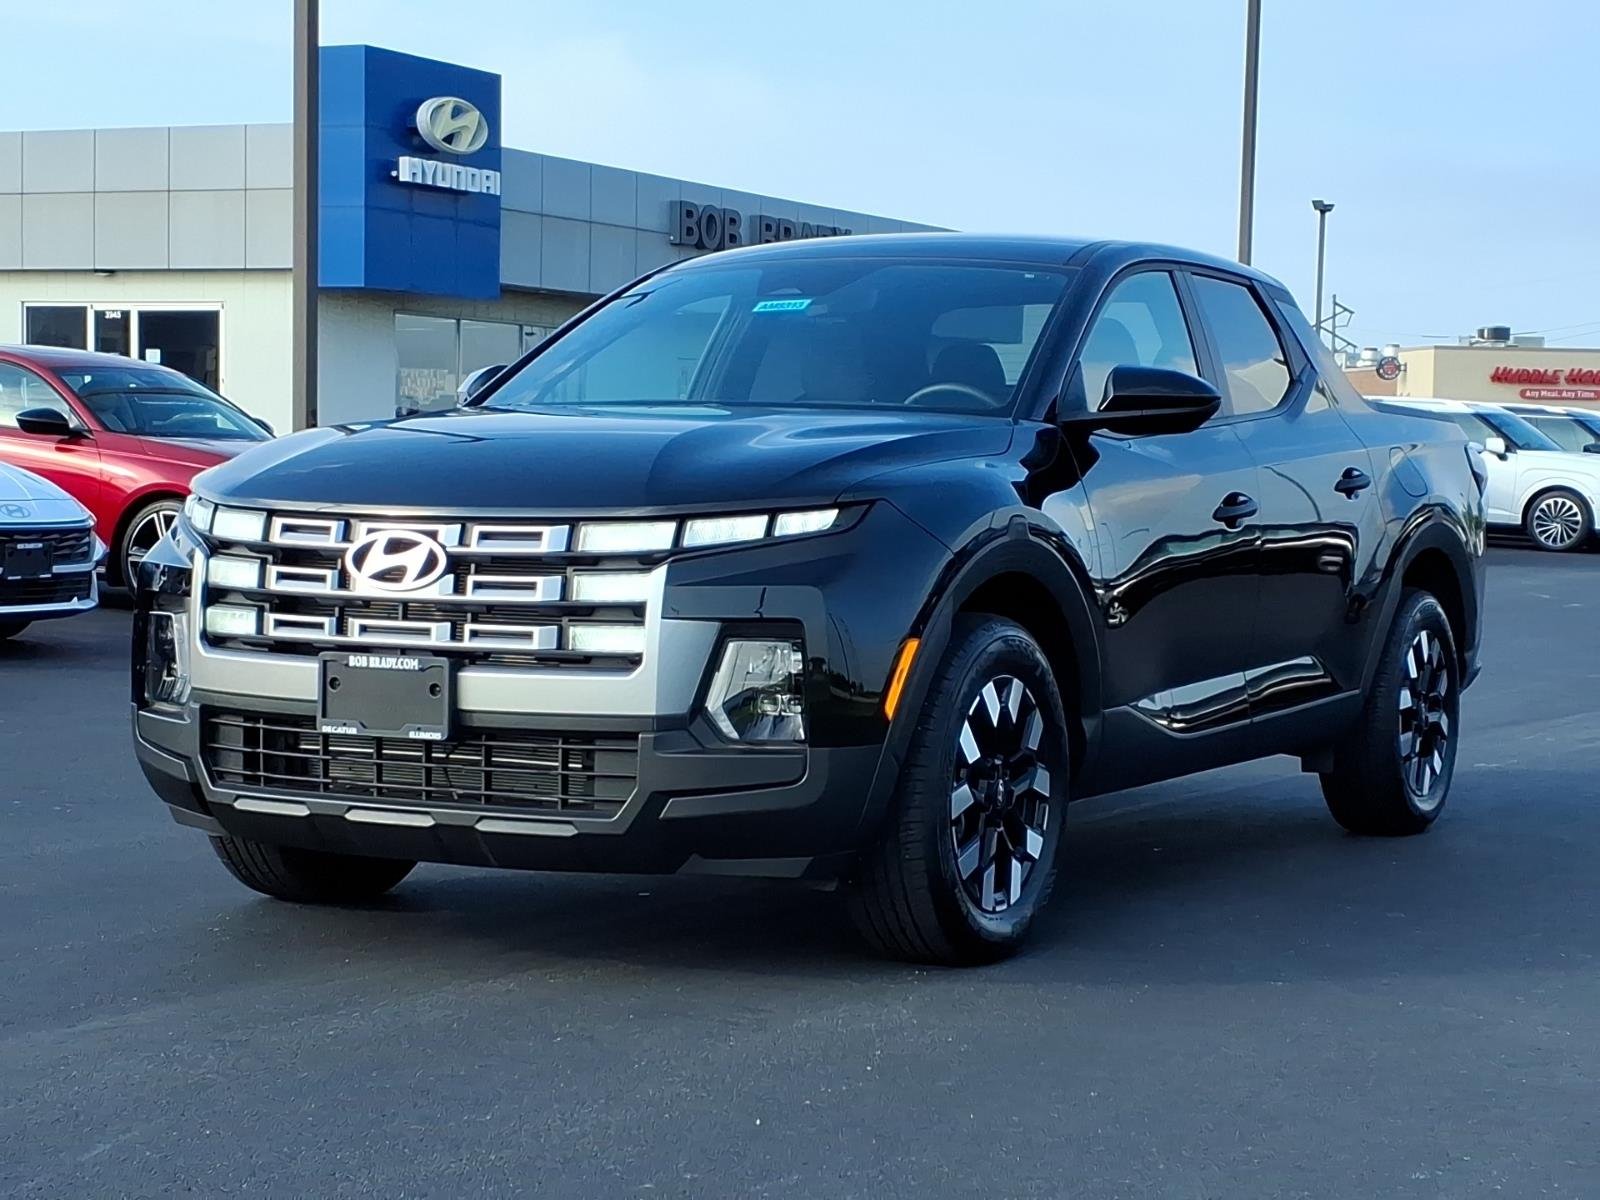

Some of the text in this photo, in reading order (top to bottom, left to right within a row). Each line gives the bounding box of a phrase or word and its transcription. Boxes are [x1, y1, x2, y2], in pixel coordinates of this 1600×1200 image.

[399, 156, 500, 195] HYUNDAI
[670, 200, 742, 250] BOB
[1490, 366, 1564, 384] HUDDLE
[1525, 390, 1539, 398] Any
[1562, 390, 1575, 398] Any
[349, 655, 419, 670] BOB BRADY.COM
[322, 725, 358, 734] DECATUR
